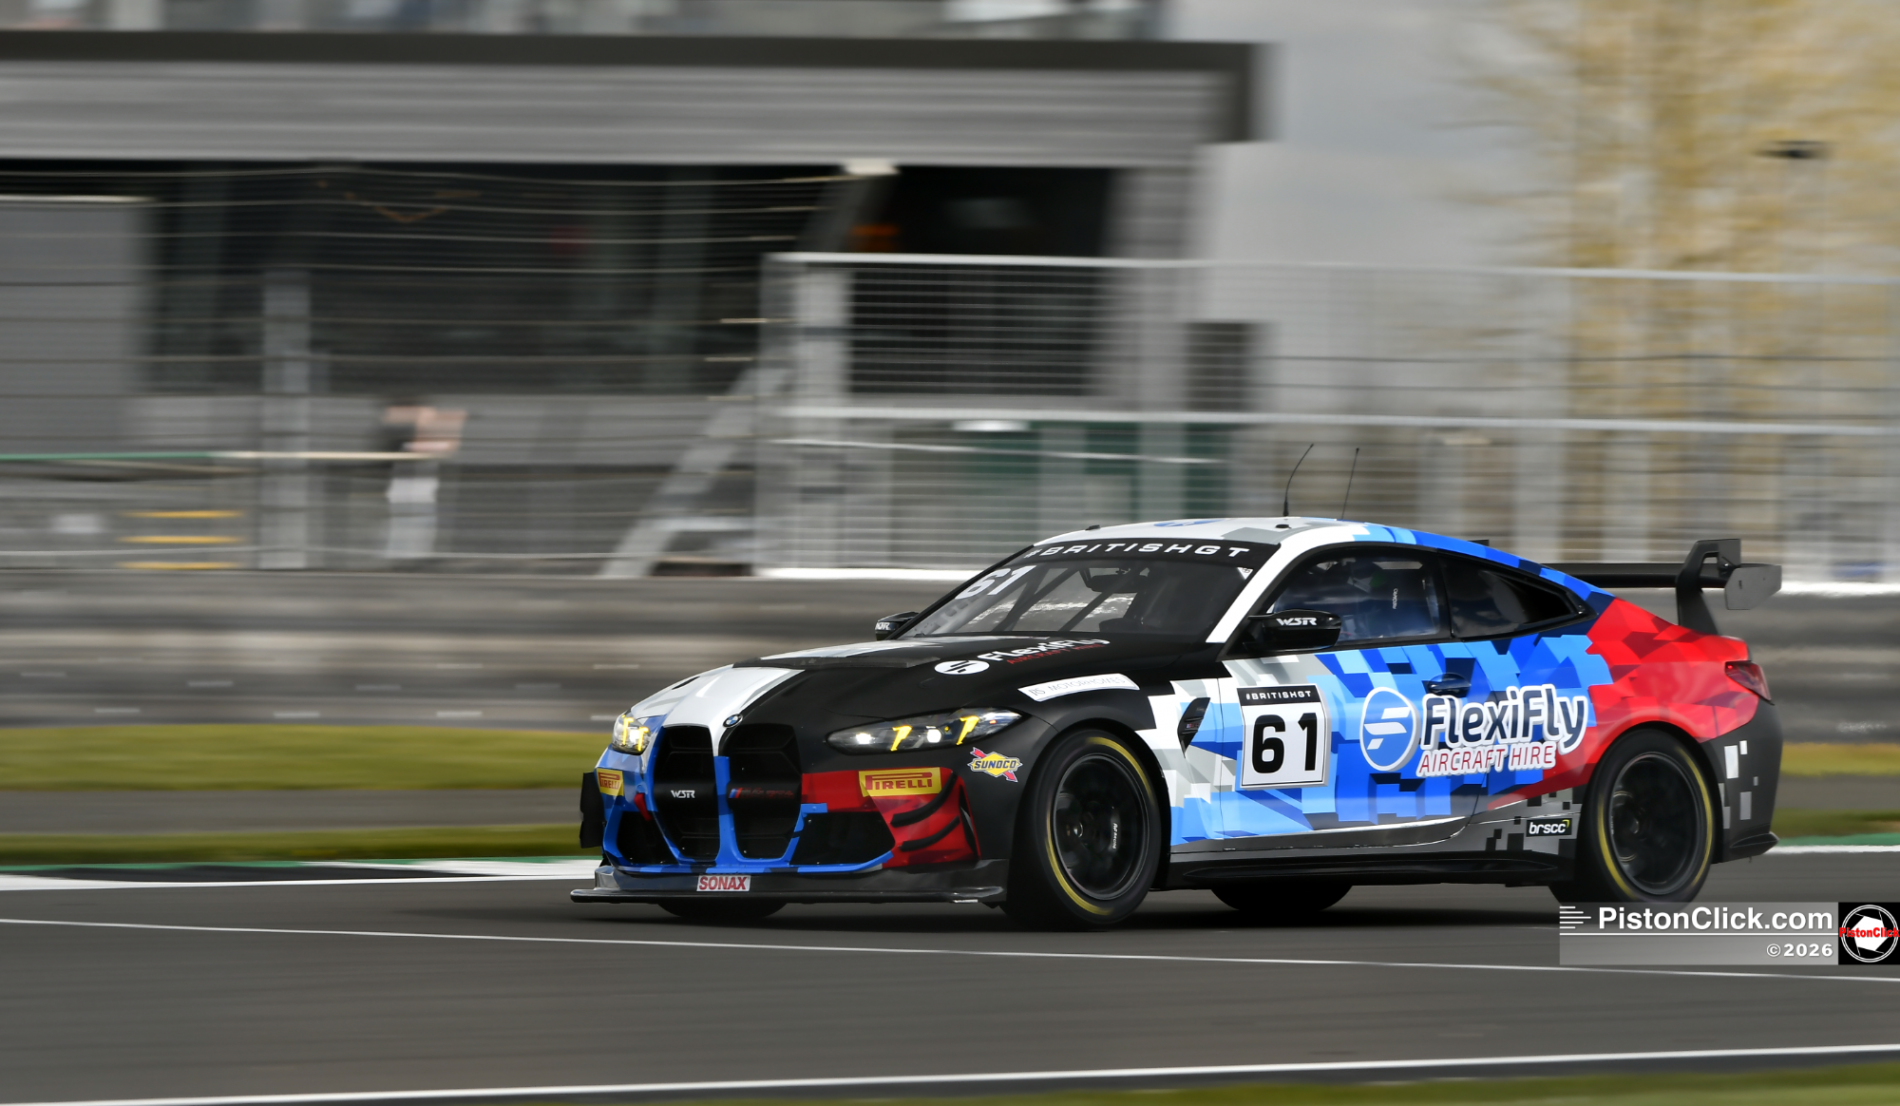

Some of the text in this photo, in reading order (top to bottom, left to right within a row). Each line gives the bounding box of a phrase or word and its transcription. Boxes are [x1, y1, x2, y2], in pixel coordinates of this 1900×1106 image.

[1023, 543, 1250, 558] #BRITISHGT
[954, 565, 1037, 599] 61
[1276, 617, 1317, 626] WSR
[1246, 690, 1312, 700] #BRITISHGT
[1423, 684, 1586, 749] FlexiFly
[1252, 712, 1318, 774] 61
[974, 760, 1017, 769] SUNOCO
[1418, 744, 1555, 774] AIRCRAFT HIRE
[598, 772, 620, 790] PIRELLI
[865, 772, 933, 790] PIRELLI
[671, 790, 695, 798] WSR
[1528, 821, 1567, 835] brscc
[699, 876, 747, 890] SONAX
